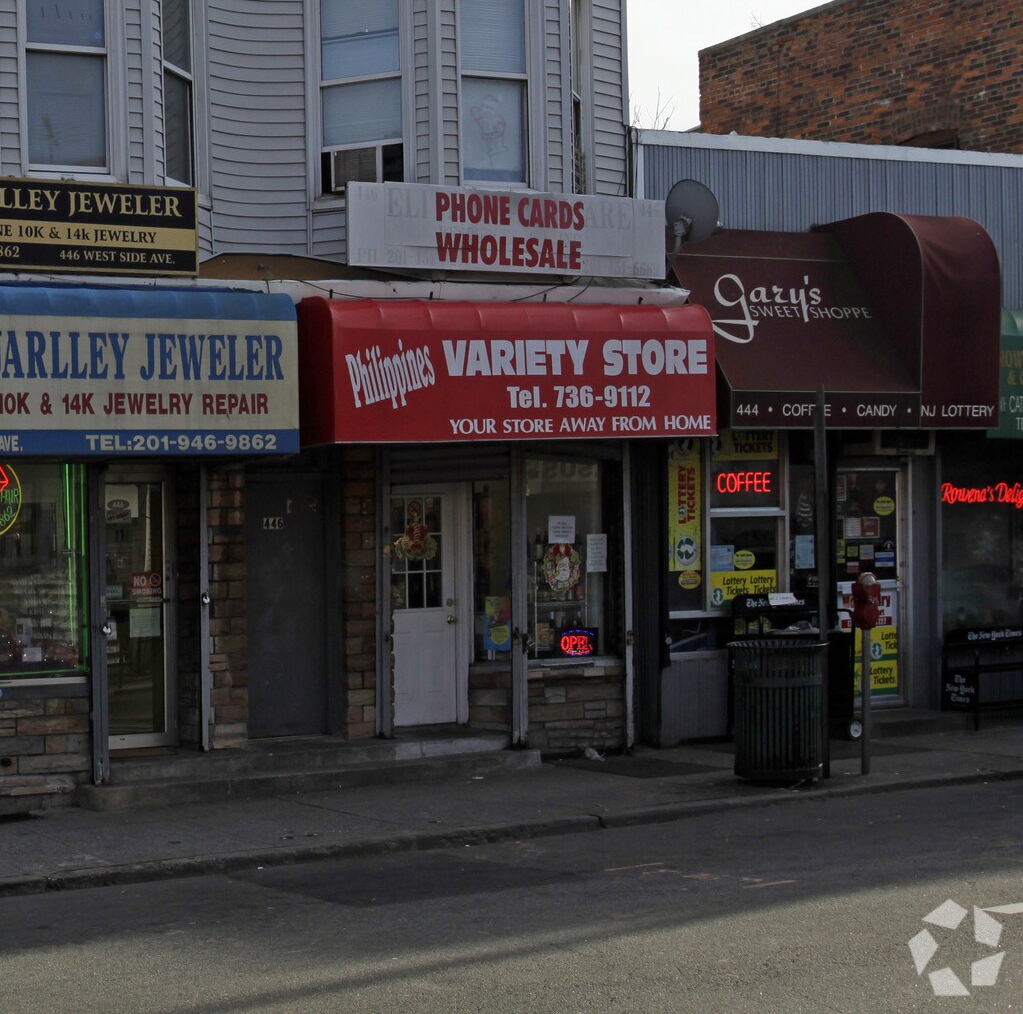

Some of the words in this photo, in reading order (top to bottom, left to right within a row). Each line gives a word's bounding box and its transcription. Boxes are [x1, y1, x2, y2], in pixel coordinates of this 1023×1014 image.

[67, 190, 182, 218] JEWELER
[436, 192, 511, 226] PHONE
[517, 197, 585, 231] CARDS
[17, 225, 46, 239] 10K
[49, 226, 62, 240] &
[65, 226, 90, 241] 14k
[91, 227, 157, 244] JEWELRY
[59, 249, 80, 261] 446
[83, 250, 117, 263] WEST
[119, 251, 148, 264] SIDE
[149, 251, 176, 265] AVE.
[435, 232, 582, 270] WHOLESALE
[749, 305, 800, 318] SWEET
[809, 306, 872, 319] SHOPPE
[139, 333, 284, 381] JEWELER
[442, 339, 589, 376] VARIETY
[602, 339, 708, 375] STORE
[344, 338, 436, 409] Philippines
[40, 392, 53, 415] &
[61, 393, 95, 415] 14K
[103, 393, 193, 416] JEWELRY
[202, 393, 269, 416] REPAIR
[507, 386, 547, 409] Tel.
[554, 386, 651, 408] 736-9112
[736, 404, 759, 416] 444
[782, 403, 832, 417] COFFE
[857, 404, 897, 417] CANDY
[921, 405, 937, 417] NJ
[942, 405, 995, 417] LOTTERY
[450, 418, 497, 434] YOUR
[503, 418, 554, 433] STORE
[559, 417, 606, 432] AWAY
[612, 416, 657, 431] FROM
[664, 415, 712, 430] HOME
[86, 433, 278, 452] TEL:201-946-9862
[733, 442, 773, 453] TICKETS
[717, 471, 772, 493] COFFEE
[687, 467, 696, 522] TICKETS
[941, 482, 995, 505] Rowena's
[264, 518, 283, 529] 446
[133, 575, 147, 587] NO
[723, 576, 747, 587] Lottery
[750, 575, 774, 586] Lottery
[131, 587, 162, 596] SMOKING
[726, 586, 749, 596] Tickets
[885, 641, 897, 650] Tick
[870, 666, 893, 676] Lottery
[873, 675, 895, 684] Tickets
